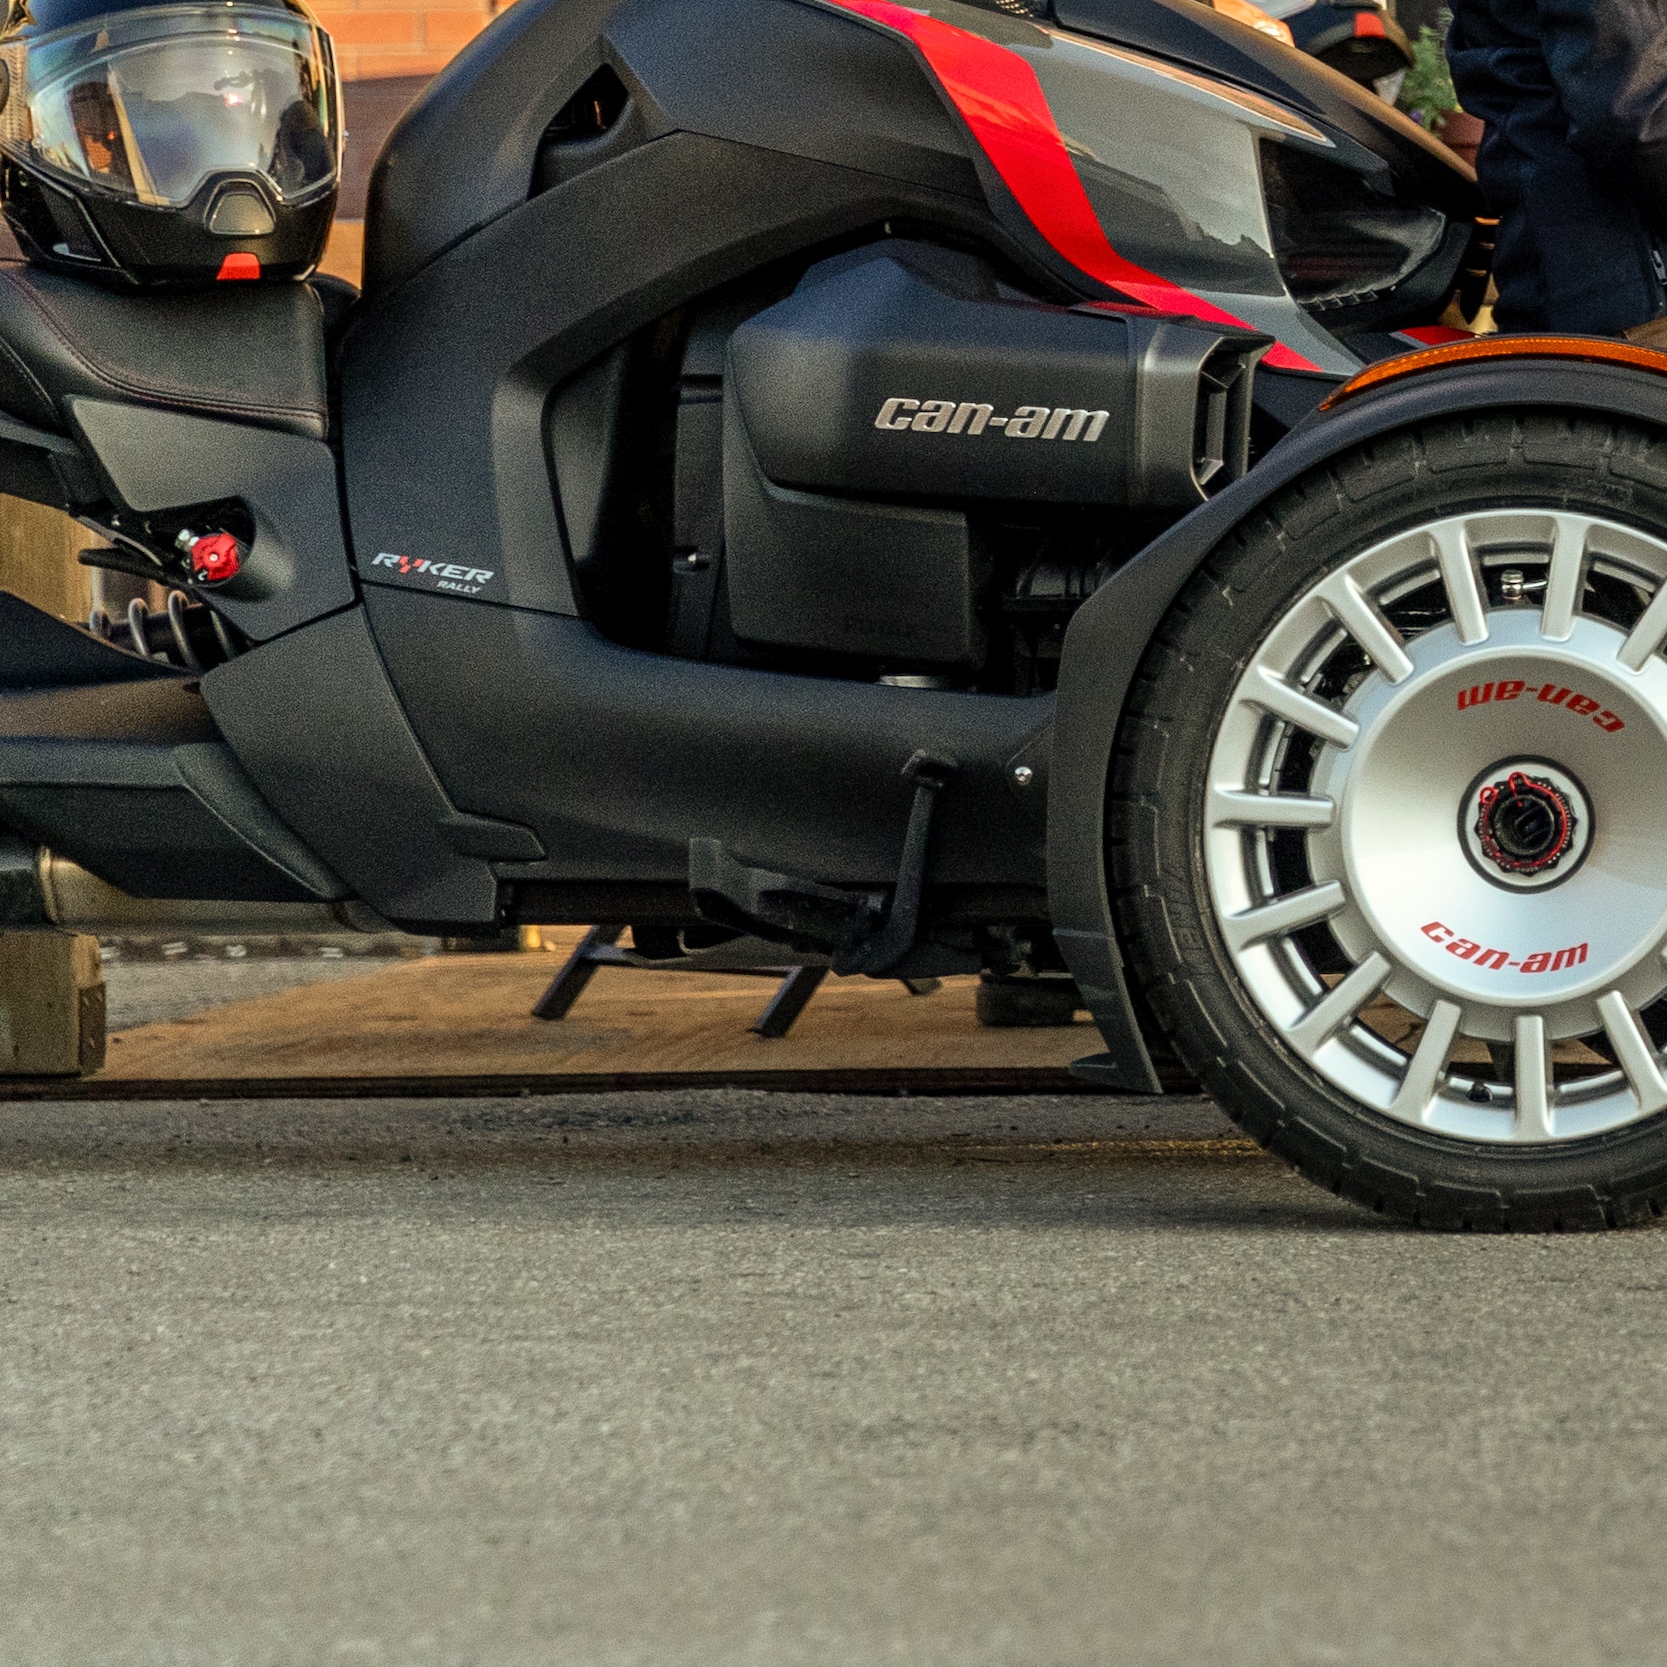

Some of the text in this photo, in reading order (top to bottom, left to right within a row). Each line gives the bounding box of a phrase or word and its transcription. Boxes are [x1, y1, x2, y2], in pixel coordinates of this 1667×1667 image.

[874, 397, 1110, 442] can-am
[371, 552, 495, 584] RYKER
[436, 580, 482, 594] RALLY
[1456, 678, 1626, 733] can-am
[1420, 921, 1589, 974] can-am
